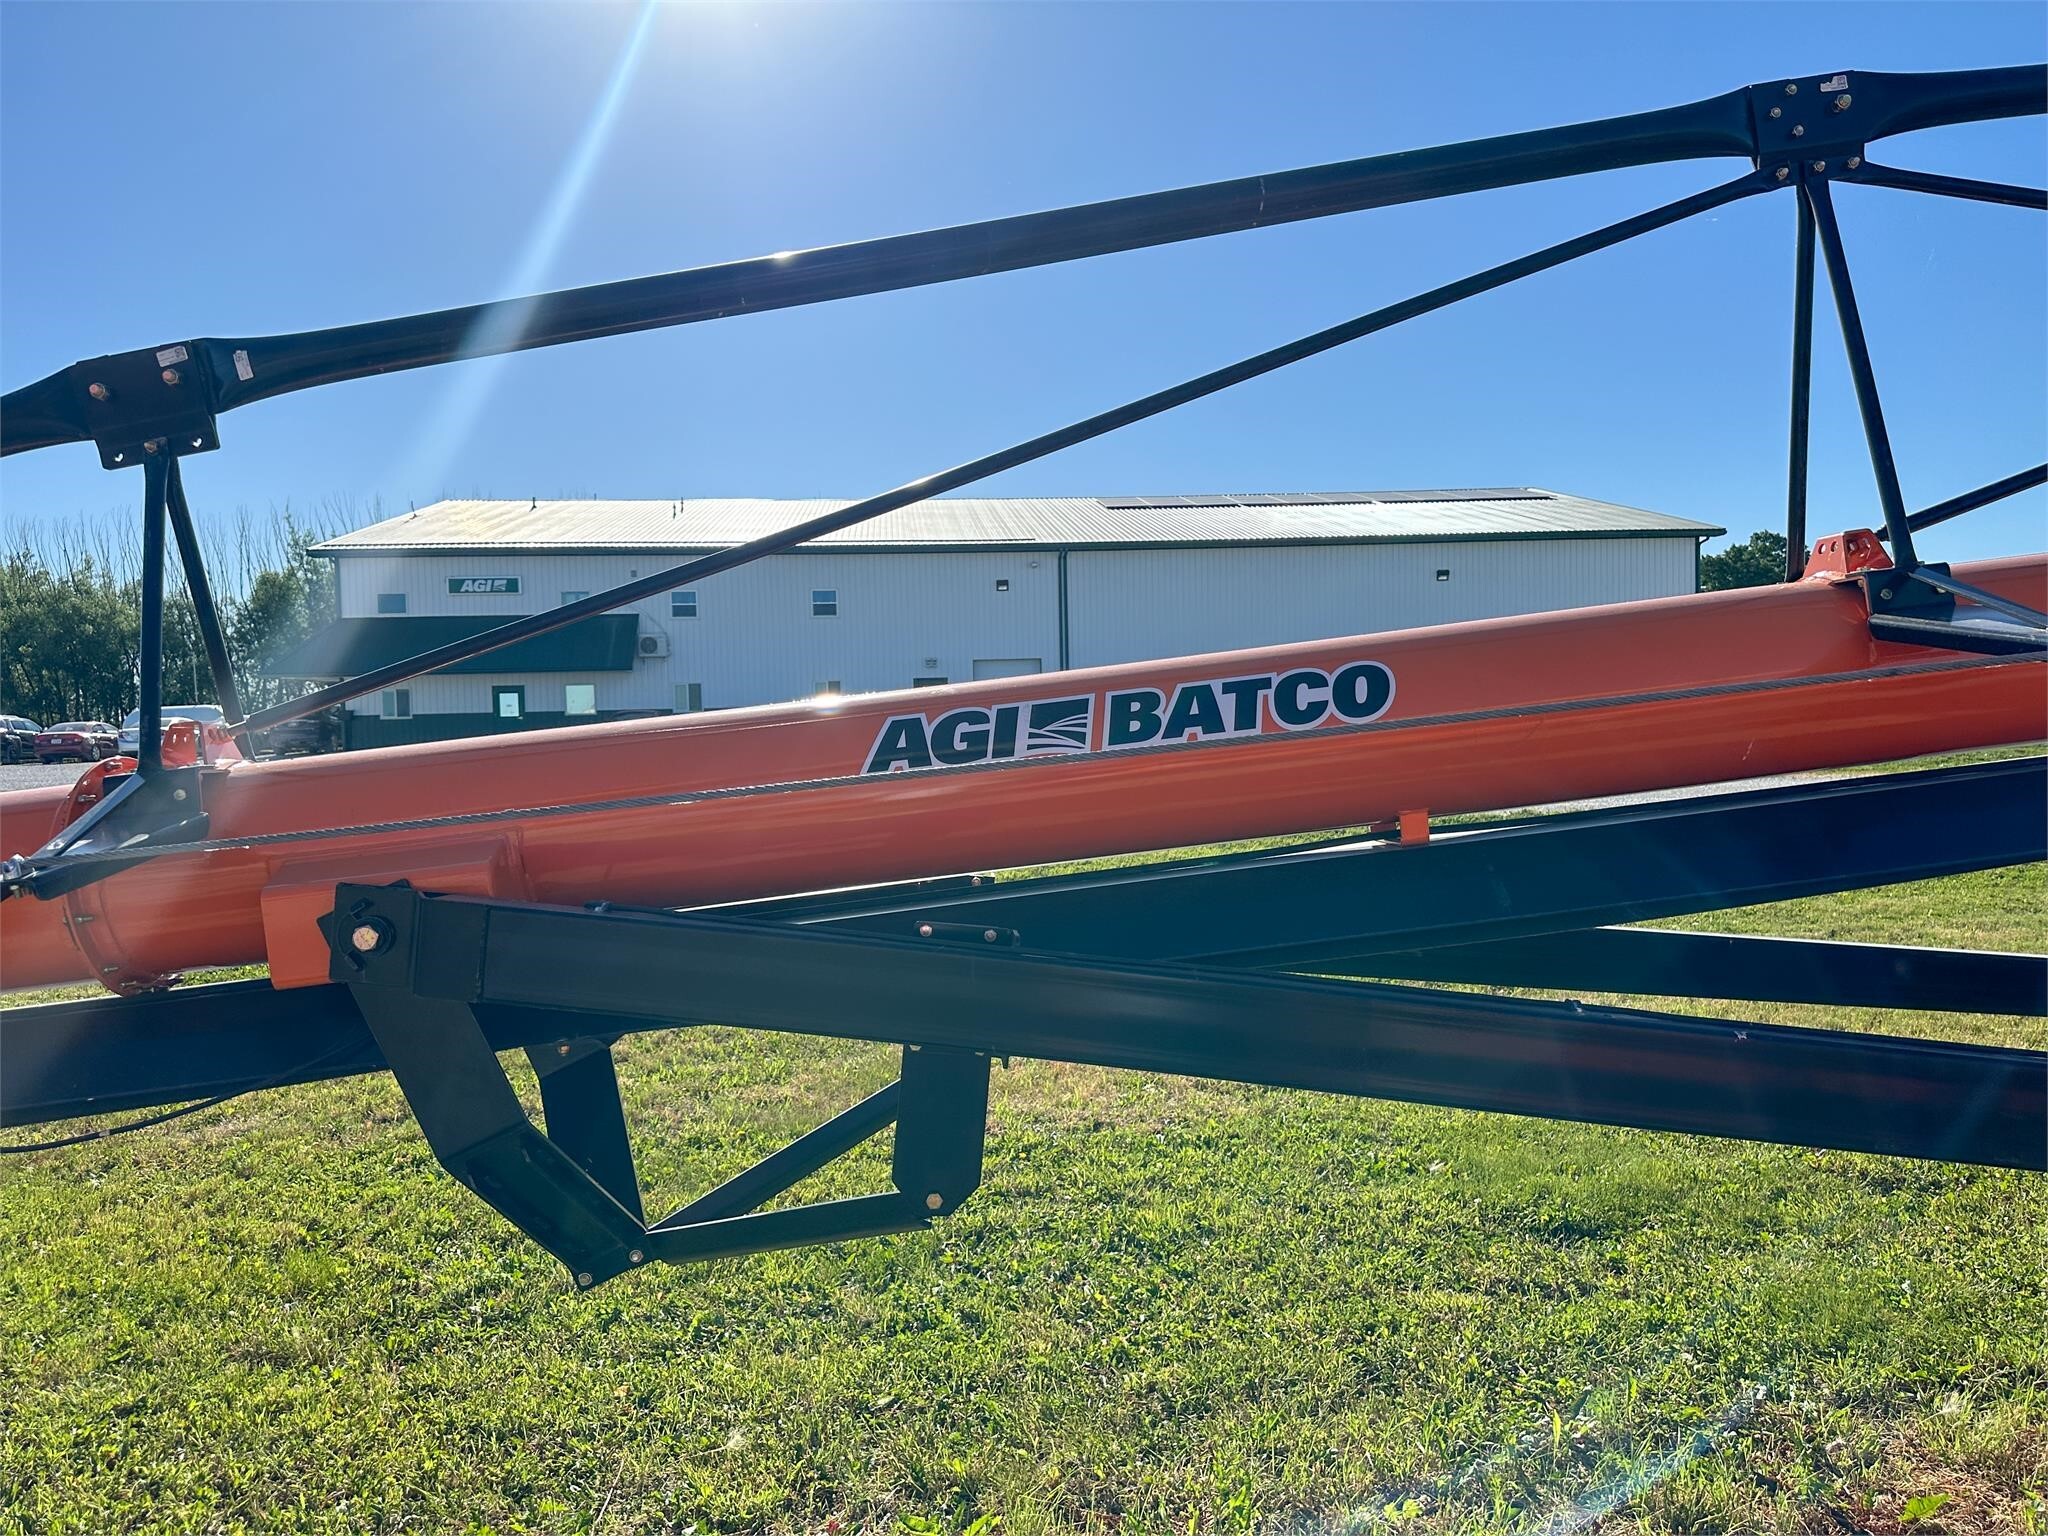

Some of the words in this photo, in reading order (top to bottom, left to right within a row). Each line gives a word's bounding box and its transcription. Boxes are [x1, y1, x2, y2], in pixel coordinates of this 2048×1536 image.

[460, 579, 493, 592] AGI
[865, 706, 1019, 773] AGI
[1108, 663, 1391, 745] BATCO
